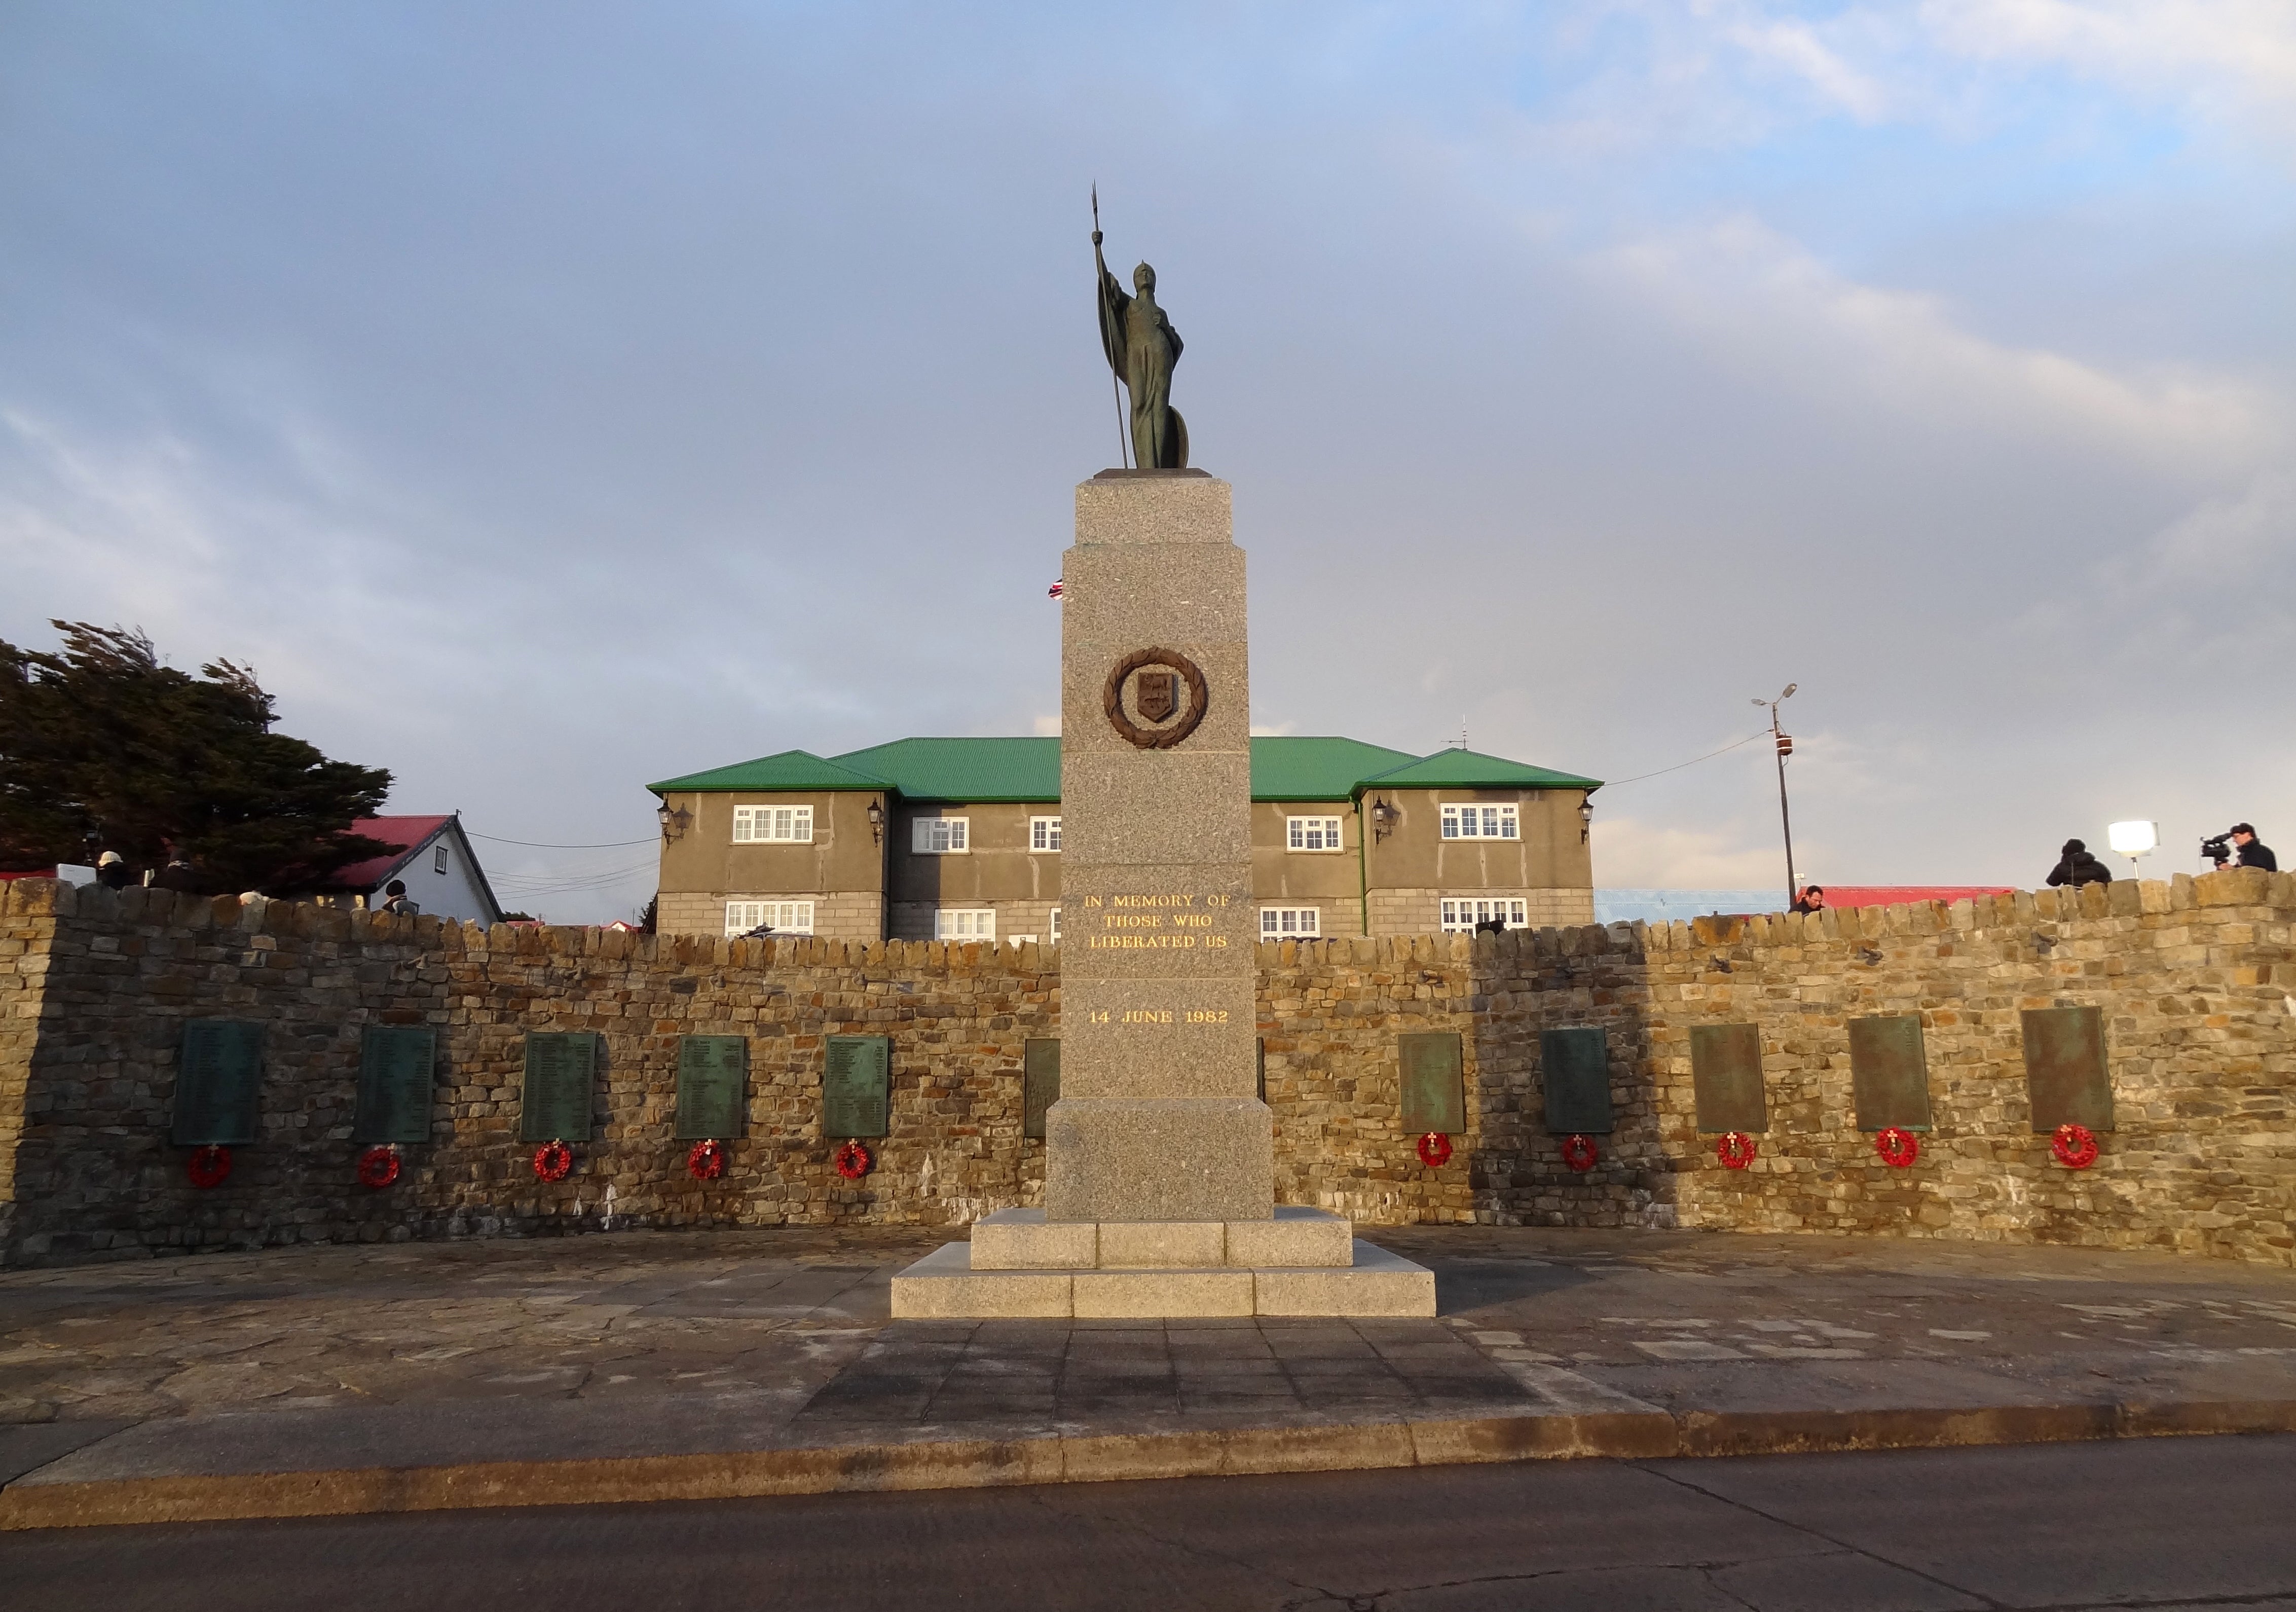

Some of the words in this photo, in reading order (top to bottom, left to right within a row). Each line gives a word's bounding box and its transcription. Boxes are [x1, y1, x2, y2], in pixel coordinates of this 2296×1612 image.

[1084, 895, 1102, 906] IN
[1114, 895, 1194, 906] MEMORY
[1207, 895, 1231, 906] OF
[1103, 915, 1162, 927] THOSE
[1173, 915, 1212, 926] WHO
[1090, 936, 1195, 948] LIBERATED
[1205, 936, 1227, 947] US
[1090, 1011, 1110, 1022] 14
[1122, 1011, 1172, 1022] JUNE
[1186, 1011, 1228, 1022] 1982
